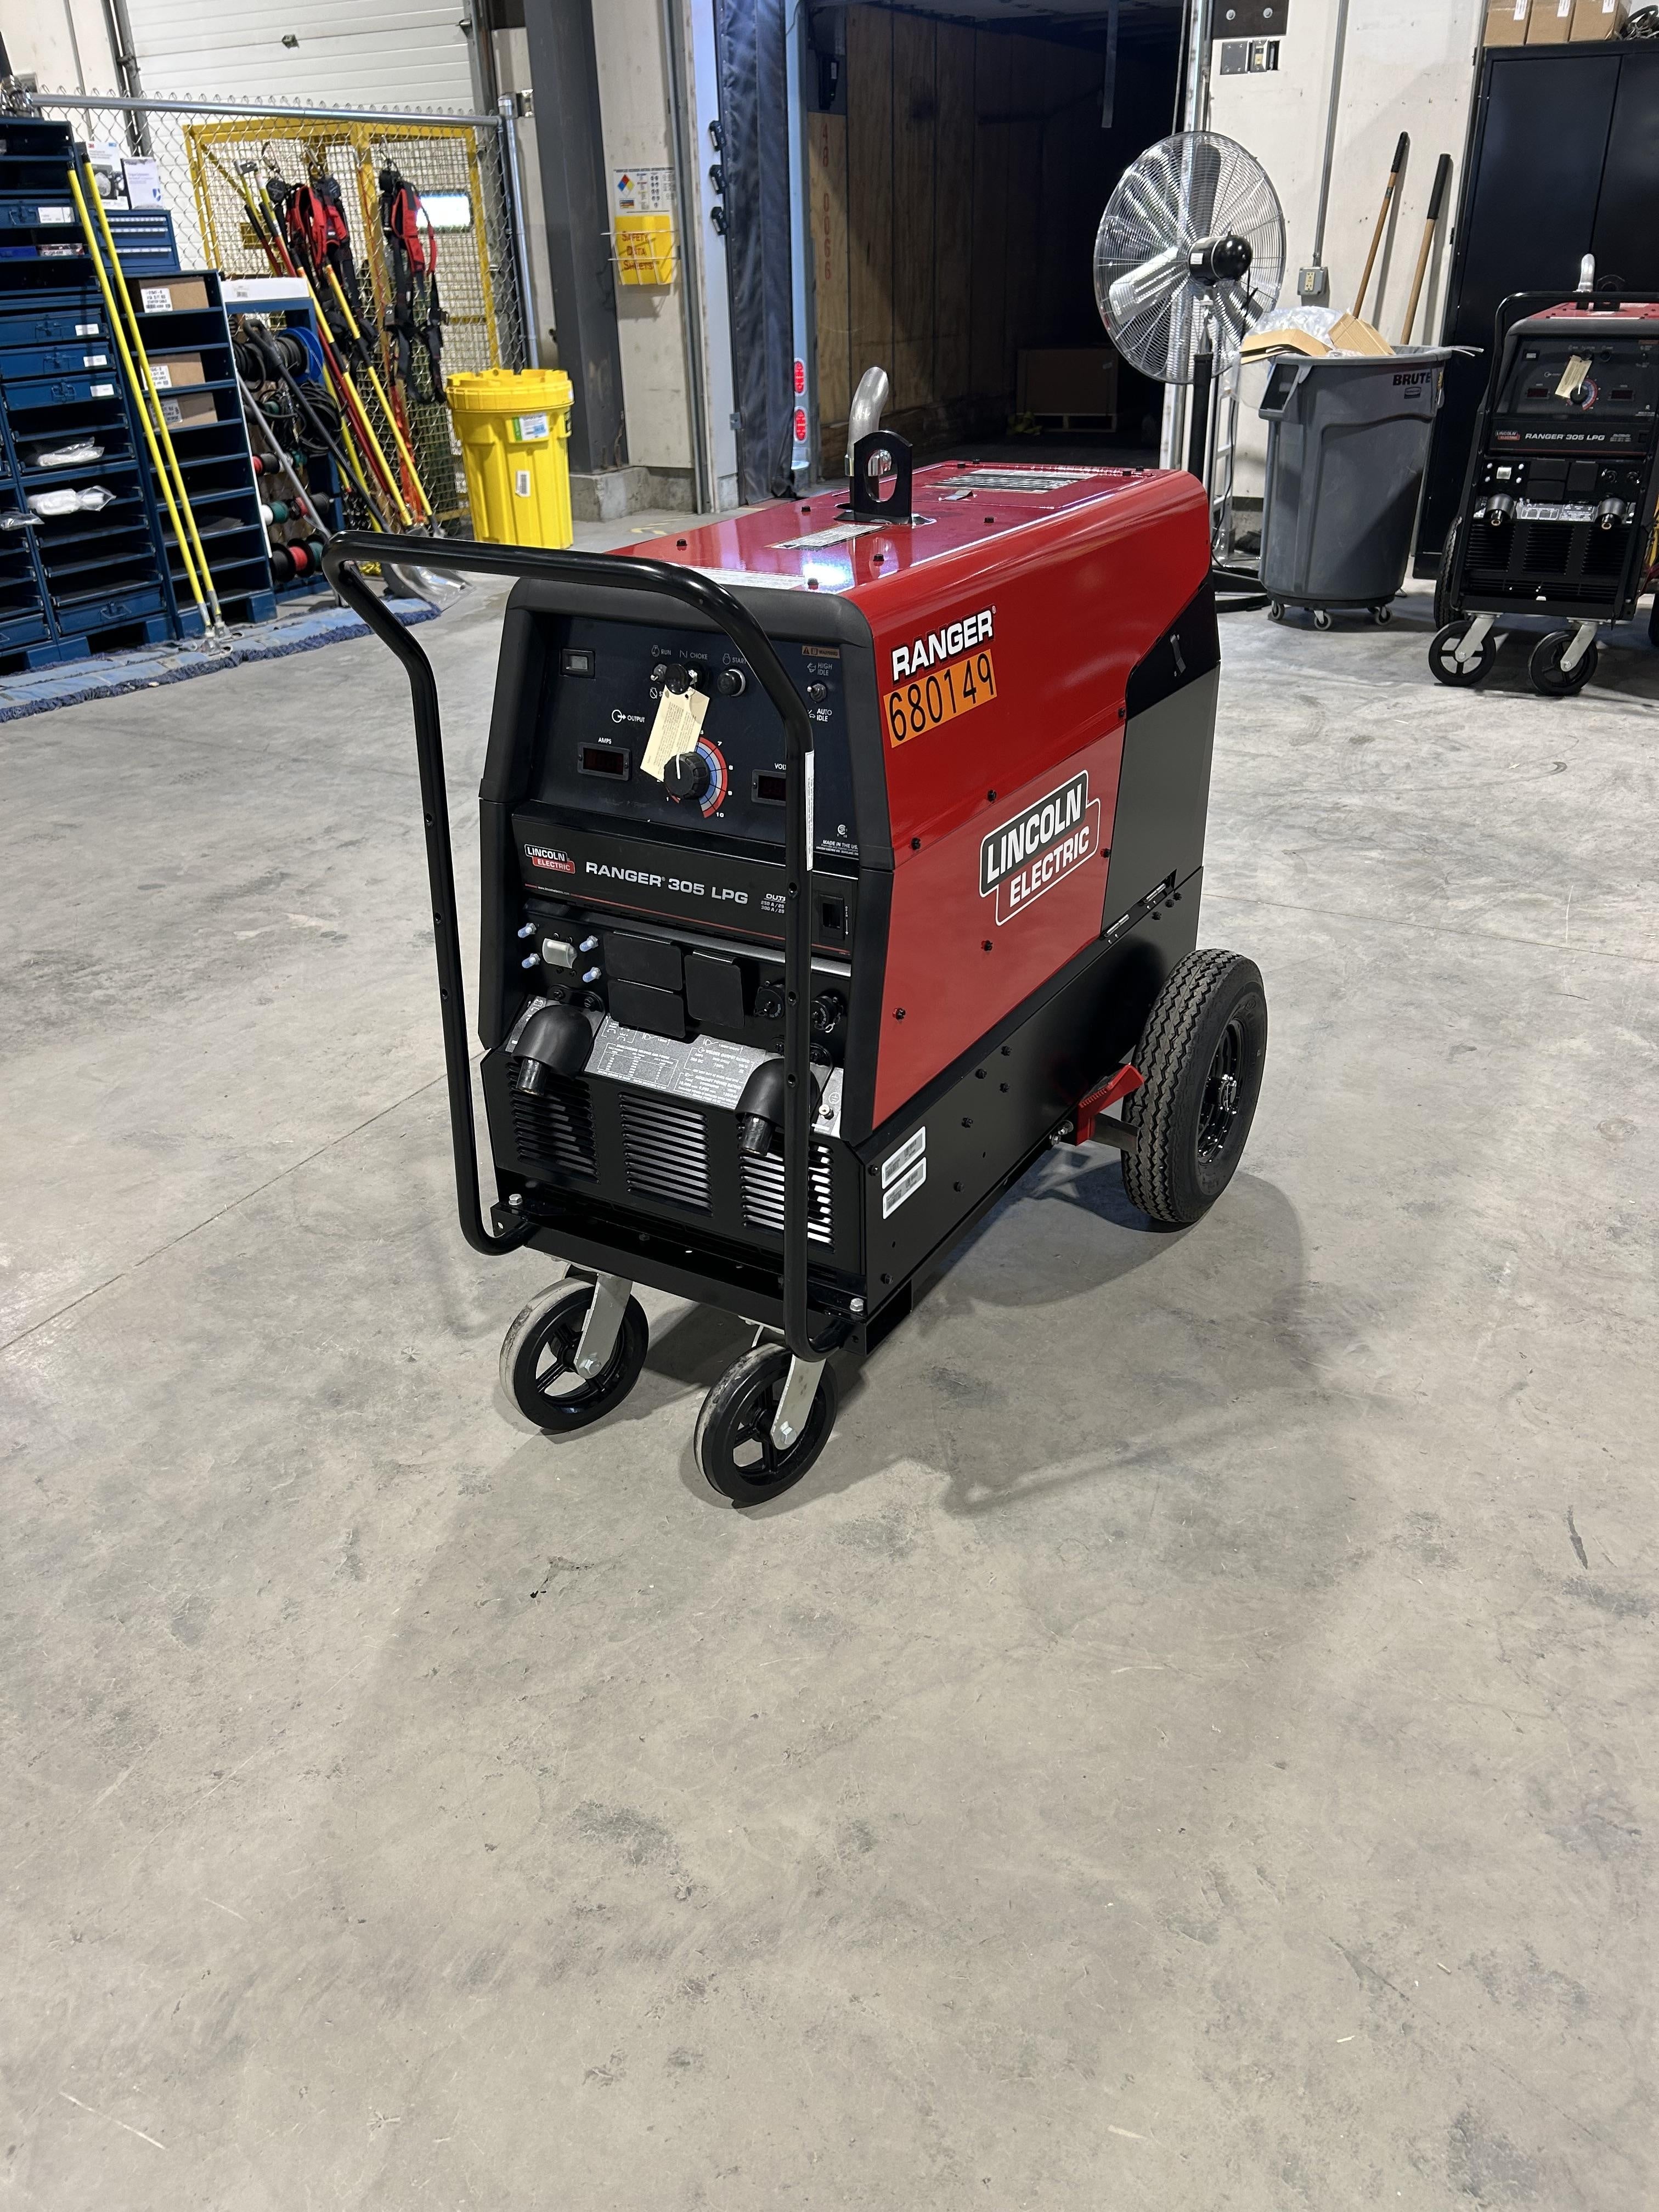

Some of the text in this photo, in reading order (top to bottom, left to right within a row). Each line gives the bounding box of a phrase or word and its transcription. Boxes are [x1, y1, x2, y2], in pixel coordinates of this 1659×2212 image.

[1393, 372, 1431, 386] BRUTE
[889, 653, 994, 741] 680149
[627, 715, 645, 723] OUTPUT
[987, 783, 1082, 884] LINCOLN
[527, 847, 565, 862] LINCOLN
[537, 859, 571, 871] ELECTRIC
[1010, 826, 1090, 907] ELECTRIC
[668, 878, 705, 895] 305
[712, 887, 748, 905] LPG
